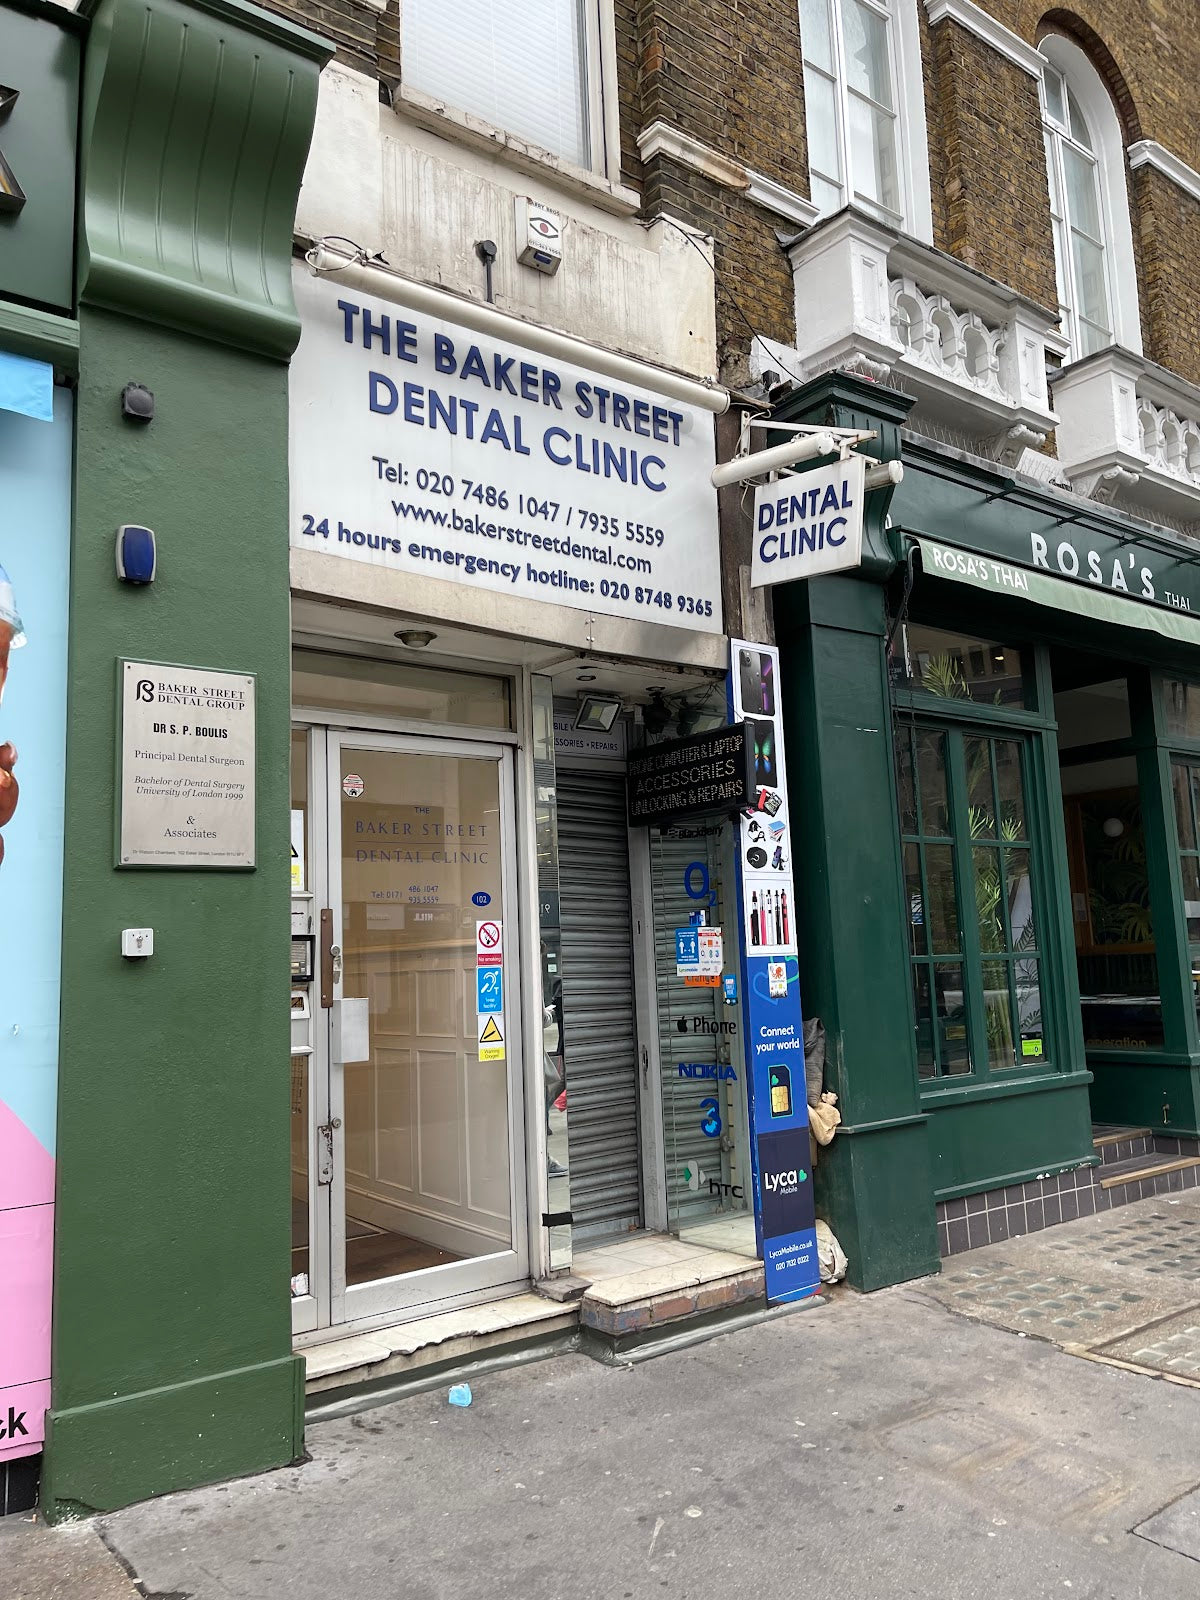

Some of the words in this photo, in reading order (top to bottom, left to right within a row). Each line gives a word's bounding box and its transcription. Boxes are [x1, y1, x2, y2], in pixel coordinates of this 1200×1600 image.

[338, 300, 418, 364] THE
[434, 332, 562, 411] BAKER
[575, 380, 684, 447] STREET
[369, 371, 531, 455] DENTAL
[543, 426, 667, 492] CLINIC
[372, 456, 409, 486] Tel:
[417, 468, 454, 497] 020
[462, 479, 509, 510] 7486
[519, 494, 560, 522] 1047
[566, 507, 573, 527] /
[578, 509, 620, 538] 7935
[626, 520, 665, 548] 5559
[758, 480, 853, 532] DENTAL
[391, 500, 652, 575] www.bakerstreetdental.com
[759, 516, 848, 564] CLINIC
[302, 514, 330, 539] 24
[338, 522, 402, 554] hours
[408, 541, 521, 583] emergency
[526, 563, 595, 594] hotline:
[600, 580, 630, 601] 020
[634, 587, 673, 610] 8748
[677, 595, 713, 617] 9365
[932, 546, 989, 581] ROSA'S
[990, 563, 1029, 592] THAI
[1030, 531, 1157, 600] ROSA'S
[1165, 590, 1191, 611] THAI
[158, 682, 198, 695] BAKER
[202, 687, 245, 700] STREET
[158, 694, 204, 707] DENTAL
[206, 699, 245, 711] GROUP
[153, 722, 166, 734] DR
[169, 724, 179, 735] S.
[182, 725, 192, 736] P.
[195, 726, 228, 739] BOULIS
[554, 737, 584, 748] SSORIES
[590, 741, 618, 751] REPAIRS
[655, 746, 700, 769] COMPUTER
[709, 735, 743, 757] LAPTOP
[134, 750, 176, 761] Principal
[178, 753, 207, 764] Dental
[209, 755, 245, 766] Surgeon
[134, 776, 173, 786] Bachelor
[173, 778, 184, 788] of
[184, 779, 211, 788] Dental
[212, 781, 245, 791] Surgery
[636, 759, 736, 795] ACCESSORIES
[136, 786, 180, 797] University
[182, 788, 192, 797] of
[192, 789, 224, 798] London
[224, 792, 244, 801] 1999
[631, 791, 687, 816] UNLOCKING
[688, 789, 697, 804] &
[698, 779, 743, 803] REPAIRS
[186, 815, 195, 825] &
[164, 828, 217, 839] Associates
[356, 821, 412, 836] BAKER
[422, 823, 487, 837] STREET
[356, 850, 424, 864] DENTAL
[432, 851, 488, 865] CLINIC
[371, 891, 385, 899] Tel:
[408, 885, 421, 893] 486
[476, 896, 487, 904] 102
[760, 1025, 794, 1038] Connect
[756, 1040, 775, 1054] your
[776, 1038, 800, 1051] world
[679, 1063, 738, 1081] NOKIA
[700, 1098, 722, 1138] 3
[764, 1169, 798, 1192] Lyca
[780, 1186, 798, 1196] Mobile
[769, 1239, 813, 1260] LycaMobile.co.uk
[775, 1261, 786, 1271] 020
